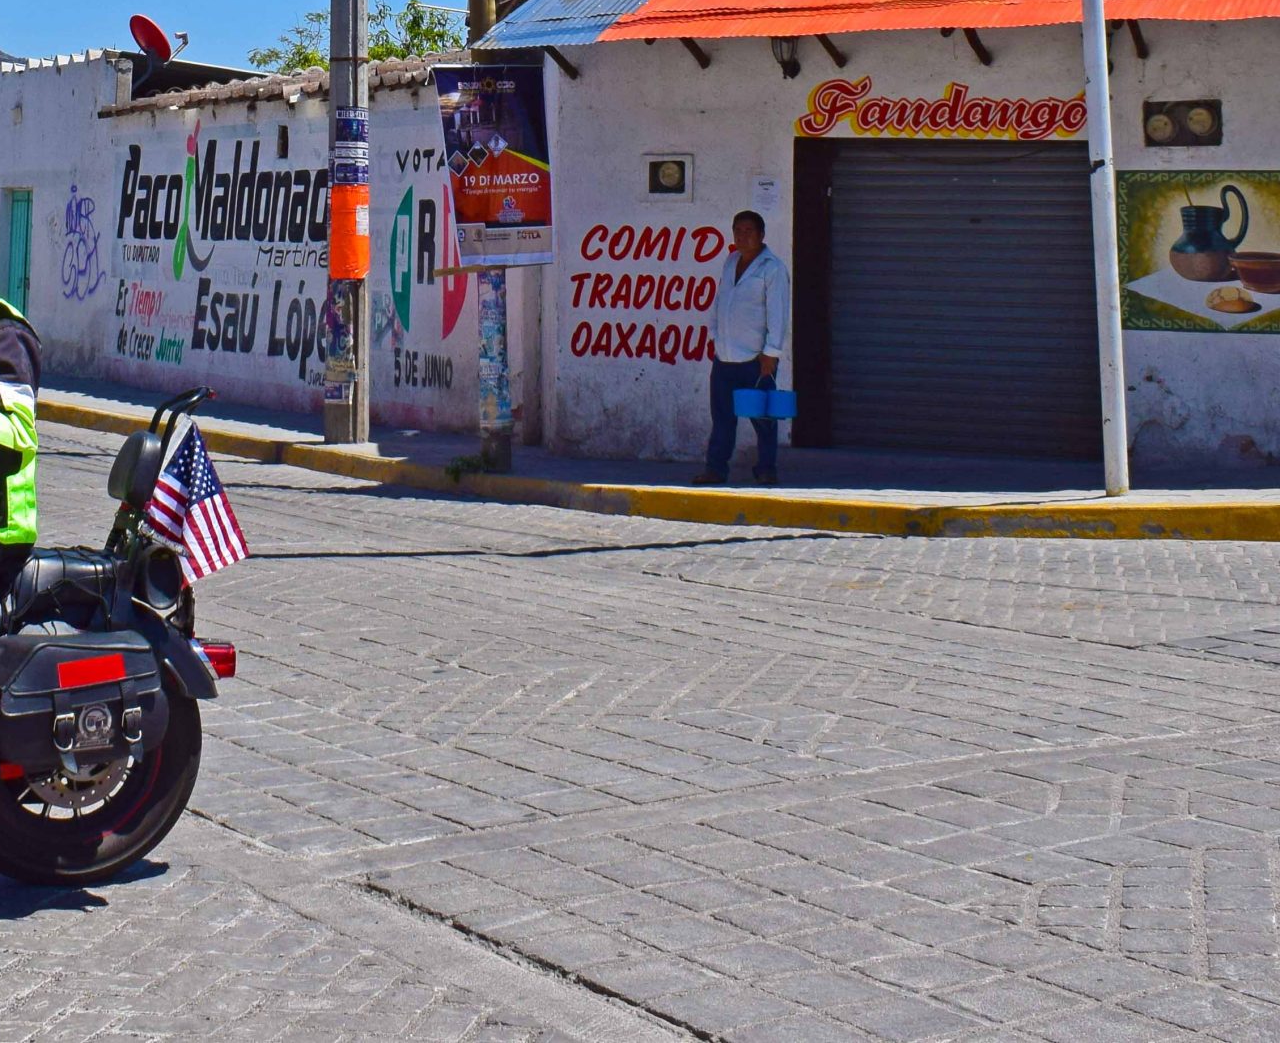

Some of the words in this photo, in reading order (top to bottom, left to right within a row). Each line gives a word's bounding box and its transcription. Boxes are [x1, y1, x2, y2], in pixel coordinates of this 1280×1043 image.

[797, 75, 1087, 141] Fandango
[117, 144, 183, 240] Paco
[194, 139, 328, 243] Maldonad
[464, 175, 476, 187] 19
[493, 172, 540, 186] MARZO
[256, 241, 328, 268] Martiné
[395, 199, 455, 292] PRI
[581, 224, 737, 263] COMID
[571, 272, 717, 312] TRADICIO
[191, 272, 260, 354] Esaú
[267, 279, 327, 381] Lópe
[394, 347, 401, 387] 5
[405, 349, 418, 387] DE
[422, 352, 453, 389] JUNIO
